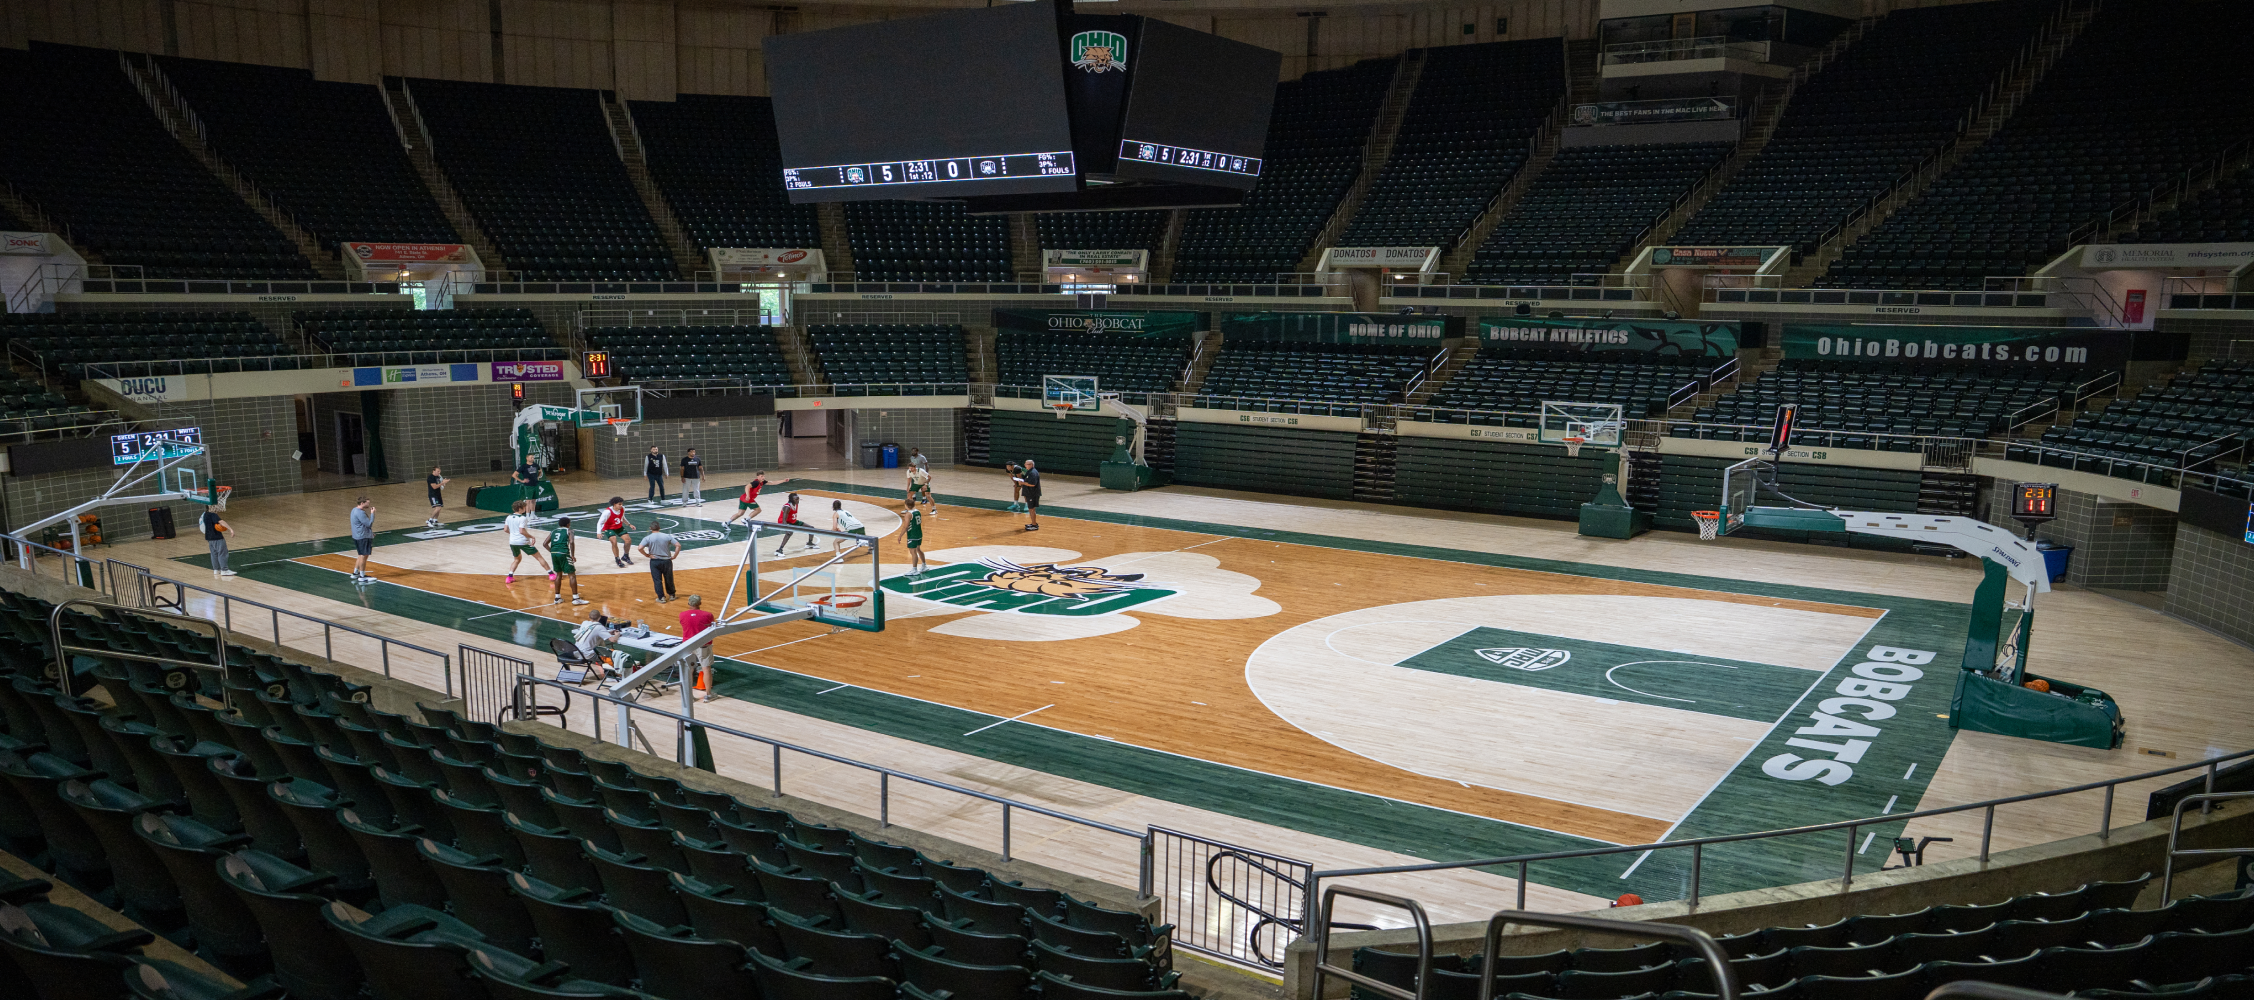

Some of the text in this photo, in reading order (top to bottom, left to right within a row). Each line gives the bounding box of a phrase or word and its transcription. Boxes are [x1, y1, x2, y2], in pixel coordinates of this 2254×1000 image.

[1071, 31, 1127, 64] OHIO
[1162, 148, 1169, 160] 5
[1180, 151, 1200, 165] 2:31
[908, 162, 929, 172] 2:31
[1219, 156, 1226, 168] 0
[882, 165, 893, 181] 5
[947, 161, 958, 178] 0
[1334, 249, 1371, 258] DONATOS
[1386, 249, 1424, 258] DONATOS
[1673, 249, 1718, 257] Casa Nueva
[1048, 317, 1145, 329] OHIO BOBCAT
[1349, 323, 1441, 339] HOME OF OHIO
[1490, 326, 1629, 344] BOBCAT ATHLETICS
[1817, 336, 2088, 364] OhioBobcats.com
[589, 354, 606, 362] 2:31
[496, 363, 559, 376] TRUSTED
[592, 362, 605, 375] 11
[1471, 429, 1481, 437] CS7
[121, 442, 130, 454] 5
[2029, 499, 2046, 512] 11
[553, 532, 561, 542] 3
[1992, 546, 2022, 568] SPALDING
[1761, 644, 1938, 787] BOBCATS
